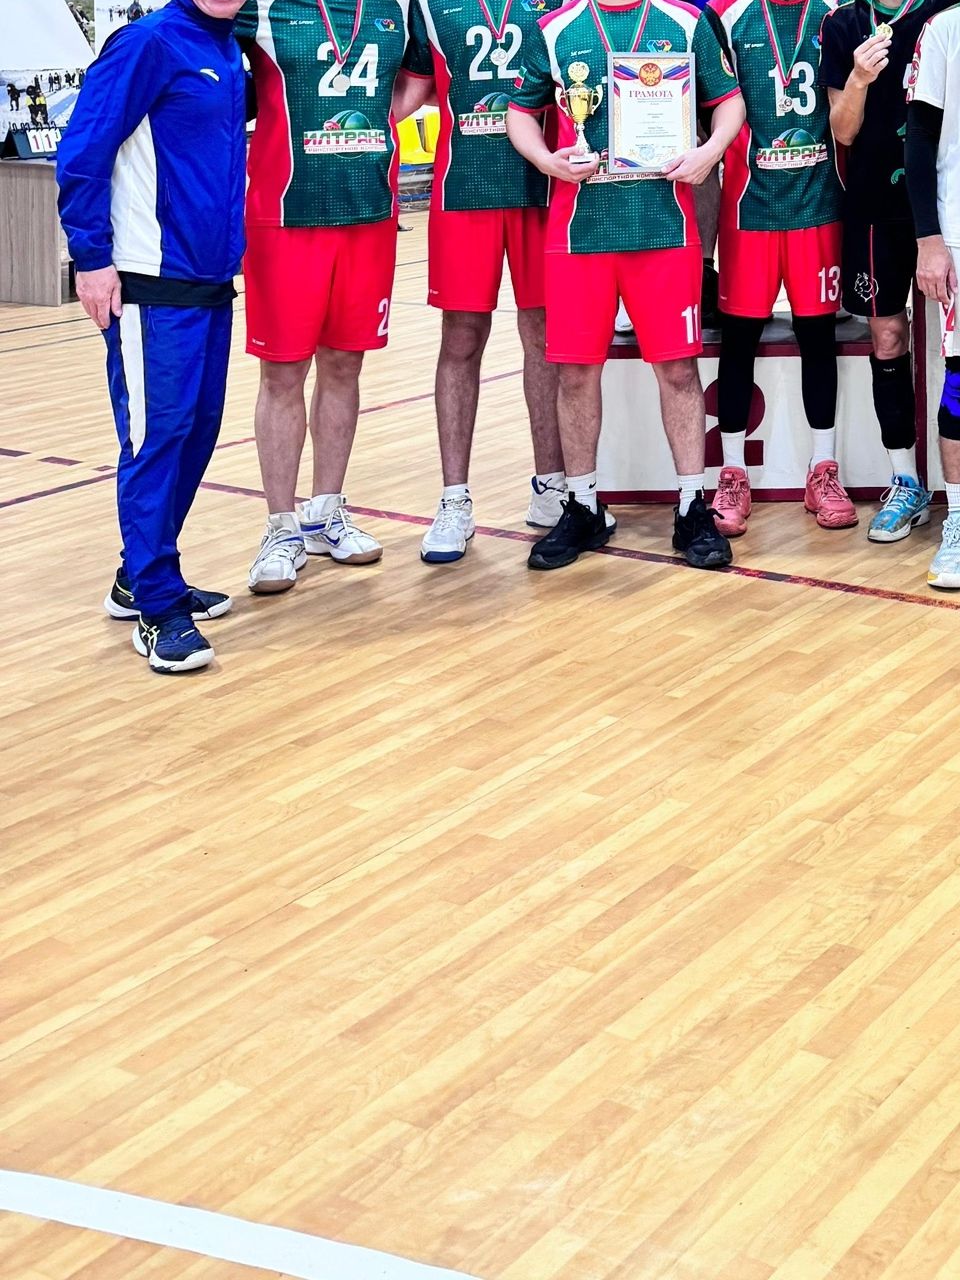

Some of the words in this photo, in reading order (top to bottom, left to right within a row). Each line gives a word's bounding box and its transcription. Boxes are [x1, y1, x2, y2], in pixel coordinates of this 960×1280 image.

[316, 41, 379, 97] 24
[466, 23, 523, 80] 22
[629, 90, 674, 98] ГРАМОТА
[768, 61, 817, 117] 13
[818, 266, 841, 303] 13
[681, 303, 699, 344] 11
